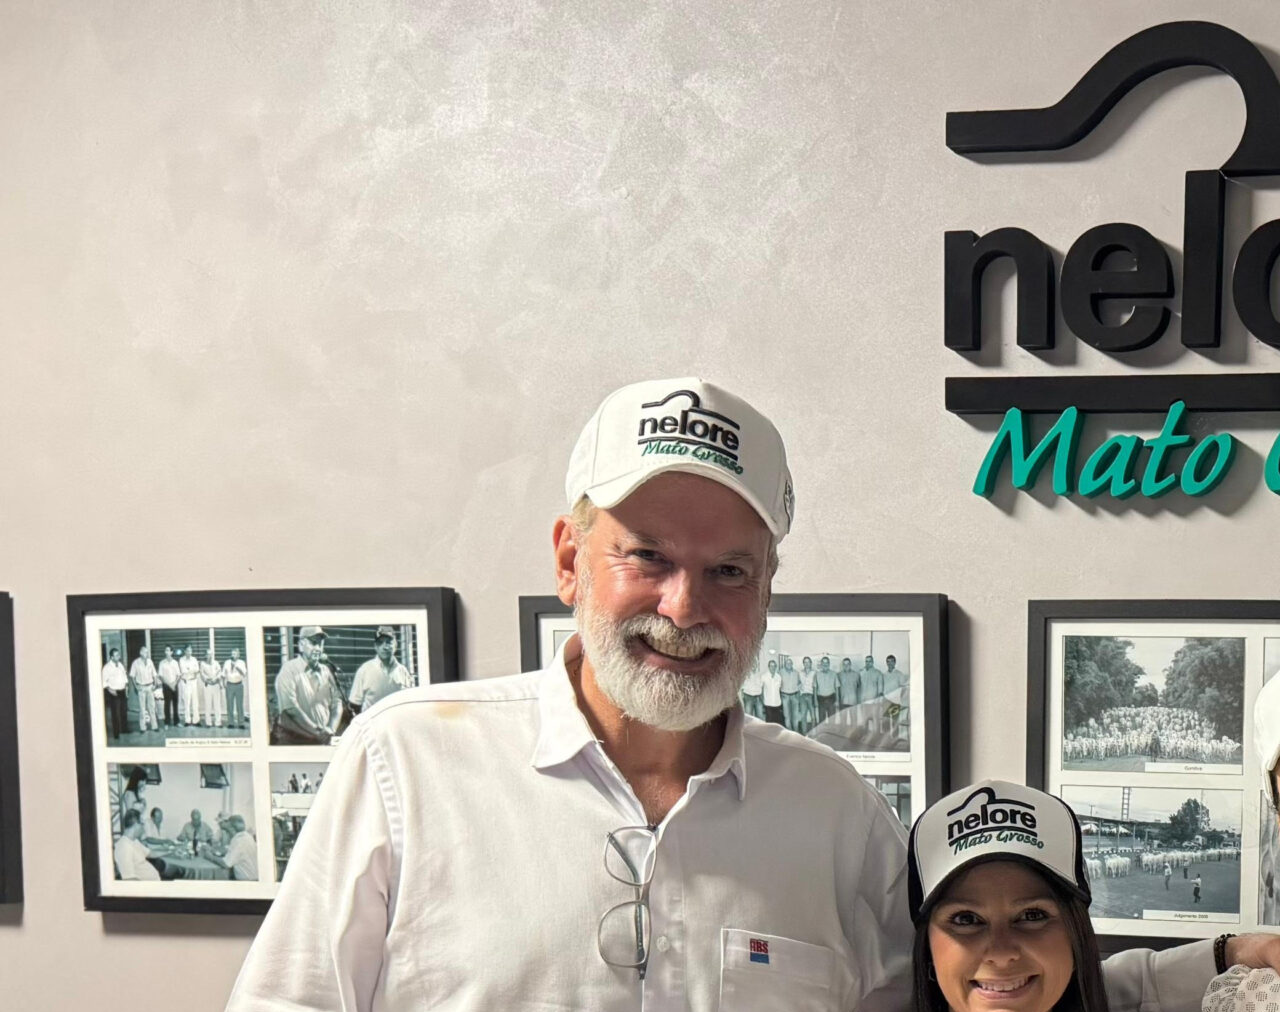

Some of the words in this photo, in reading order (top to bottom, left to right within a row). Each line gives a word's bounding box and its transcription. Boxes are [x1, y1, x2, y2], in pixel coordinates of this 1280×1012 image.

[638, 410, 740, 451] nelore
[642, 439, 689, 457] Mato
[692, 444, 744, 475] Grosso
[972, 400, 1237, 499] Mato
[947, 804, 1037, 840] nelore
[953, 830, 992, 856] Mato
[996, 829, 1045, 850] Grosso
